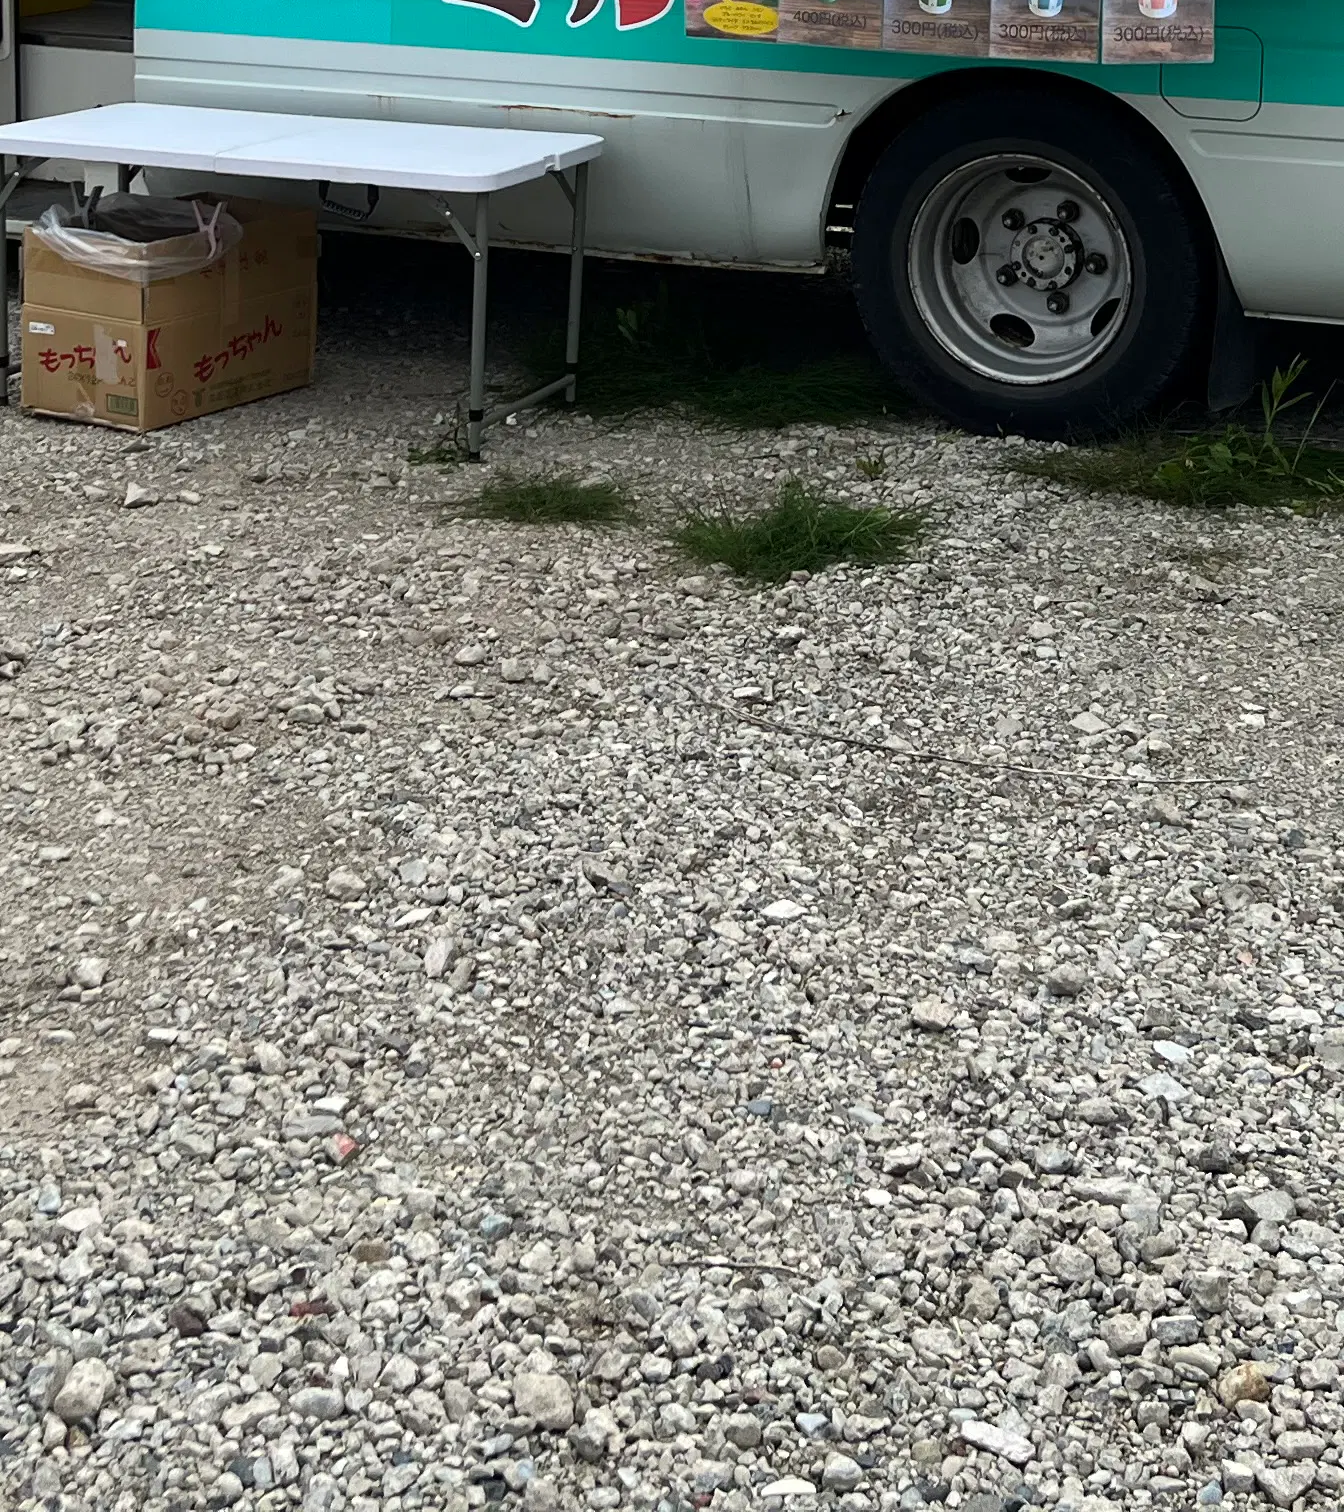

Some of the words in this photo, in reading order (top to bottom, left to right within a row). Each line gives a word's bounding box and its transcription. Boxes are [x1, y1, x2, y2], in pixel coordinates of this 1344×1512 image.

[193, 315, 283, 384] もっちゃん
